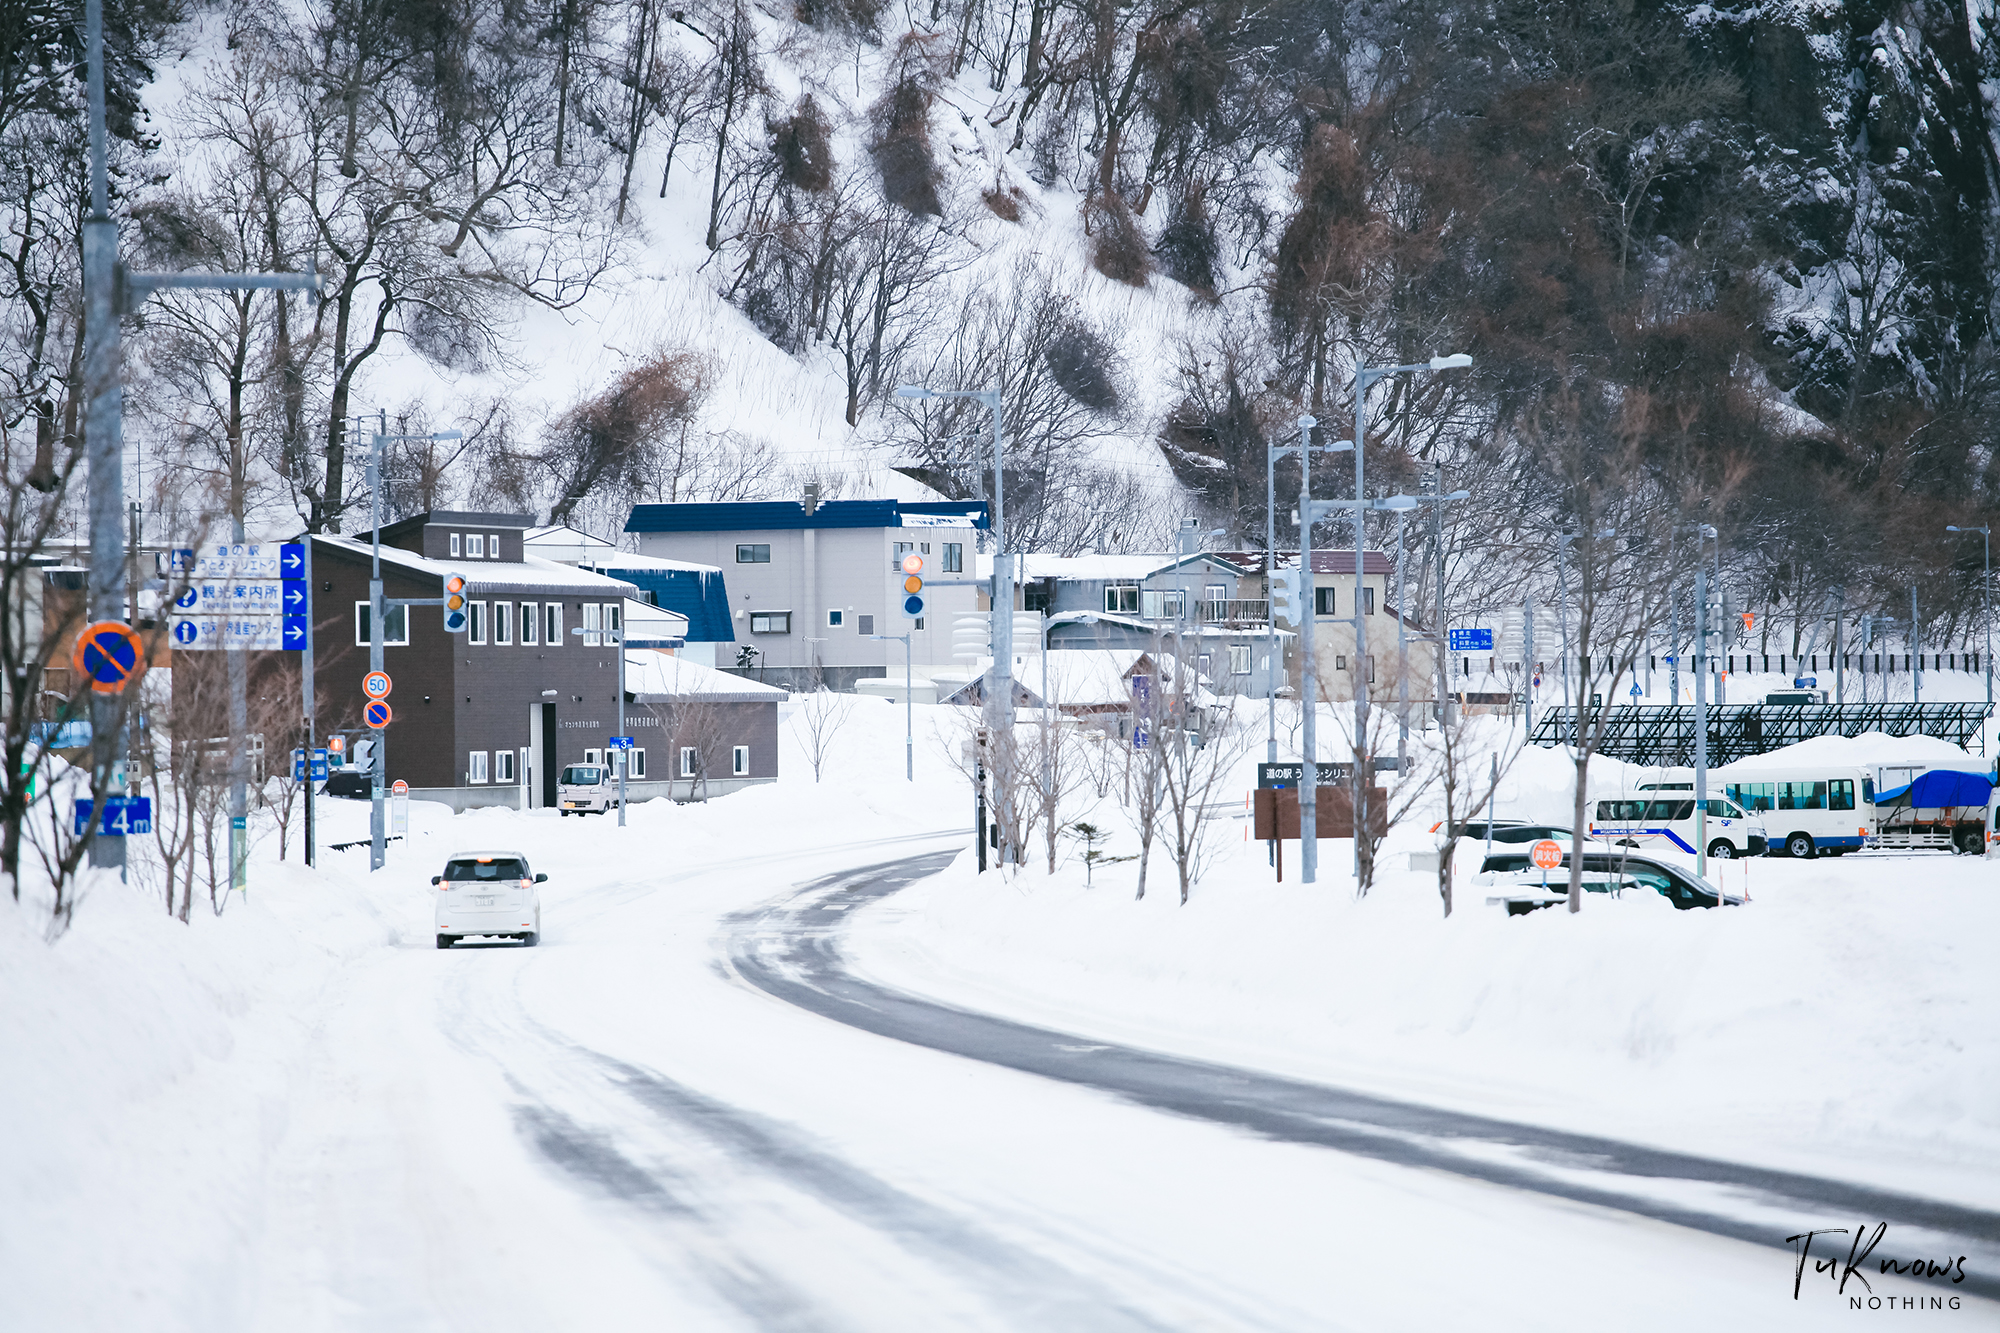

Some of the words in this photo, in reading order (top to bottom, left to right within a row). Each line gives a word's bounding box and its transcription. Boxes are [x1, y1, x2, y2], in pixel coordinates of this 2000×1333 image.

[216, 544, 260, 556] 道の駅
[202, 585, 278, 599] 観光案内所
[369, 679, 386, 691] 50
[1266, 768, 1293, 779] 道の駅
[1535, 849, 1560, 862] 消火栓
